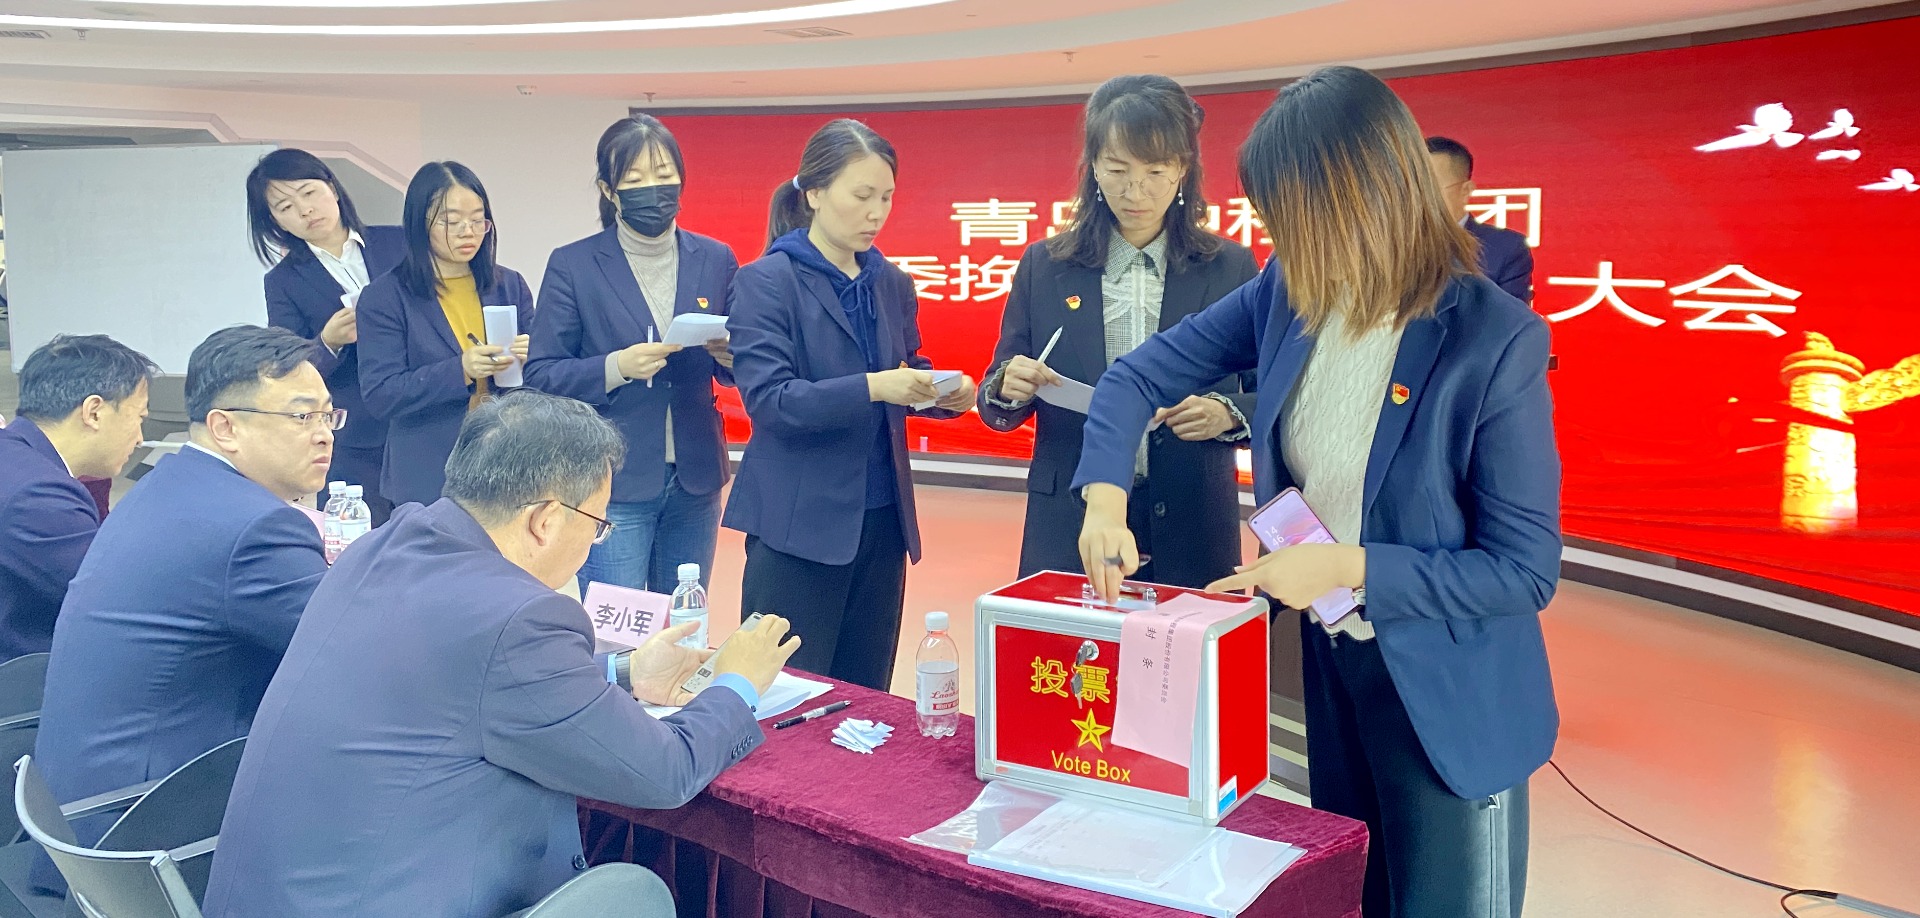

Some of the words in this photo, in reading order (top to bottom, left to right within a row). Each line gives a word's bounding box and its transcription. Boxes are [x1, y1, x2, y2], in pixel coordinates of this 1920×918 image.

[1546, 261, 1803, 338] 大会
[594, 603, 654, 637] 李小军
[1030, 656, 1118, 703] 投票
[1051, 750, 1091, 775] Vote
[1096, 759, 1131, 783] Box
